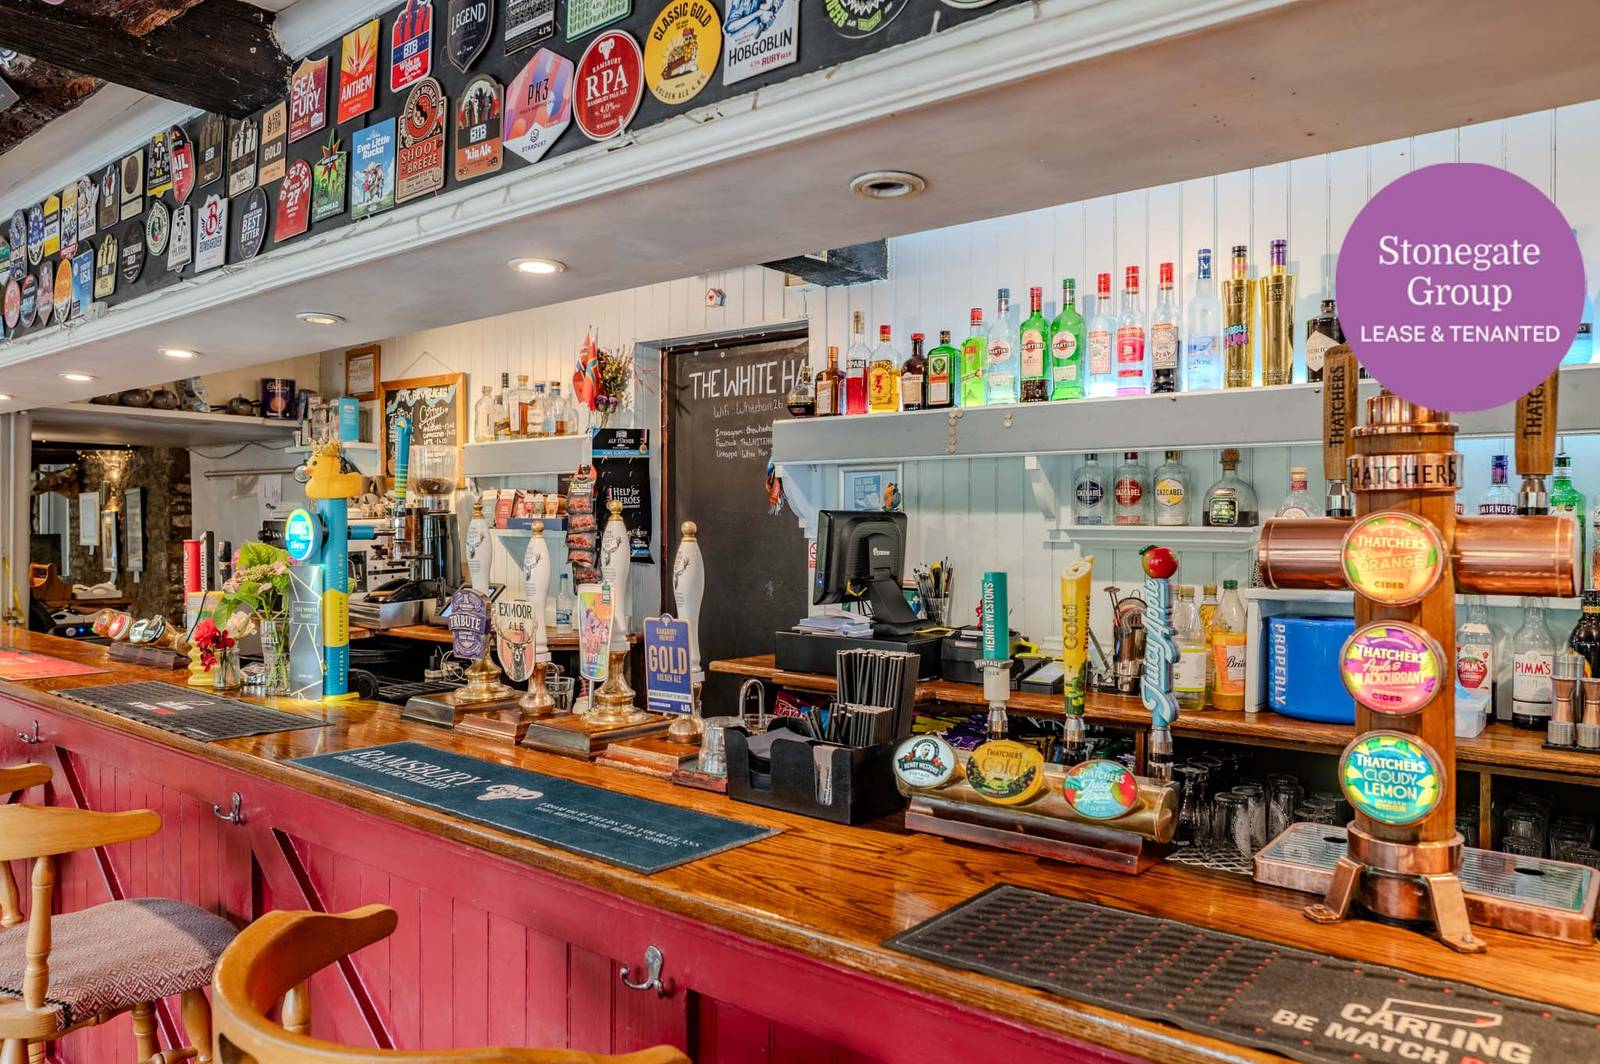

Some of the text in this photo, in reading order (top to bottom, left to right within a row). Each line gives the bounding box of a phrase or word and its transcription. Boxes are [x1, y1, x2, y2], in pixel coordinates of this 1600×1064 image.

[451, 2, 487, 35] LEGEND
[653, 1, 712, 41] CLASSIC GOLD
[728, 27, 793, 67] HOBGOBLIN
[293, 72, 315, 101] SEA
[341, 73, 373, 102] ANTHEM
[527, 78, 550, 106] PK3
[586, 64, 630, 101] RPA
[264, 142, 282, 161] GOLD
[401, 138, 438, 164] SHOOT
[406, 154, 438, 174] BREEZE
[286, 189, 302, 207] 27
[242, 214, 262, 233] BEST
[241, 227, 260, 243] BITTER
[689, 358, 809, 400] THE WHITE HA
[1329, 365, 1345, 448] THATCHERS
[1523, 380, 1545, 439] THATC
[613, 487, 640, 497] HELP for
[613, 496, 640, 504] HEROES
[1115, 489, 1141, 497] CAZCABEL
[1156, 488, 1184, 496] CAZCABEL
[1357, 535, 1428, 550] THATCHERS
[1360, 554, 1425, 570] ORANGE
[1374, 581, 1405, 590] CIDER
[499, 602, 532, 619] EXMOOR
[985, 582, 995, 652] HENRY WESTONS
[449, 614, 481, 631] TRIBUTE
[509, 621, 525, 631] ALE
[1063, 604, 1079, 651] Gold
[648, 645, 688, 675] GOLD
[1357, 643, 1427, 664] THATCHERS
[1274, 623, 1287, 705] PROPERLY
[1457, 662, 1485, 673] PIMM'S
[1515, 661, 1551, 675] PIMM'S
[1353, 670, 1427, 686] BLACKCURRANT
[1372, 692, 1403, 702] CIDER
[987, 748, 1023, 760] THATCHERS
[1356, 753, 1427, 774] THATCHERS
[351, 750, 491, 787] RAMSBURY
[981, 758, 1022, 776] Gold
[1363, 768, 1418, 786] CLOUDY
[1363, 782, 1418, 800] LEMON
[1271, 1009, 1450, 1064] BE MATCH
[1340, 1002, 1534, 1064] CARLING
